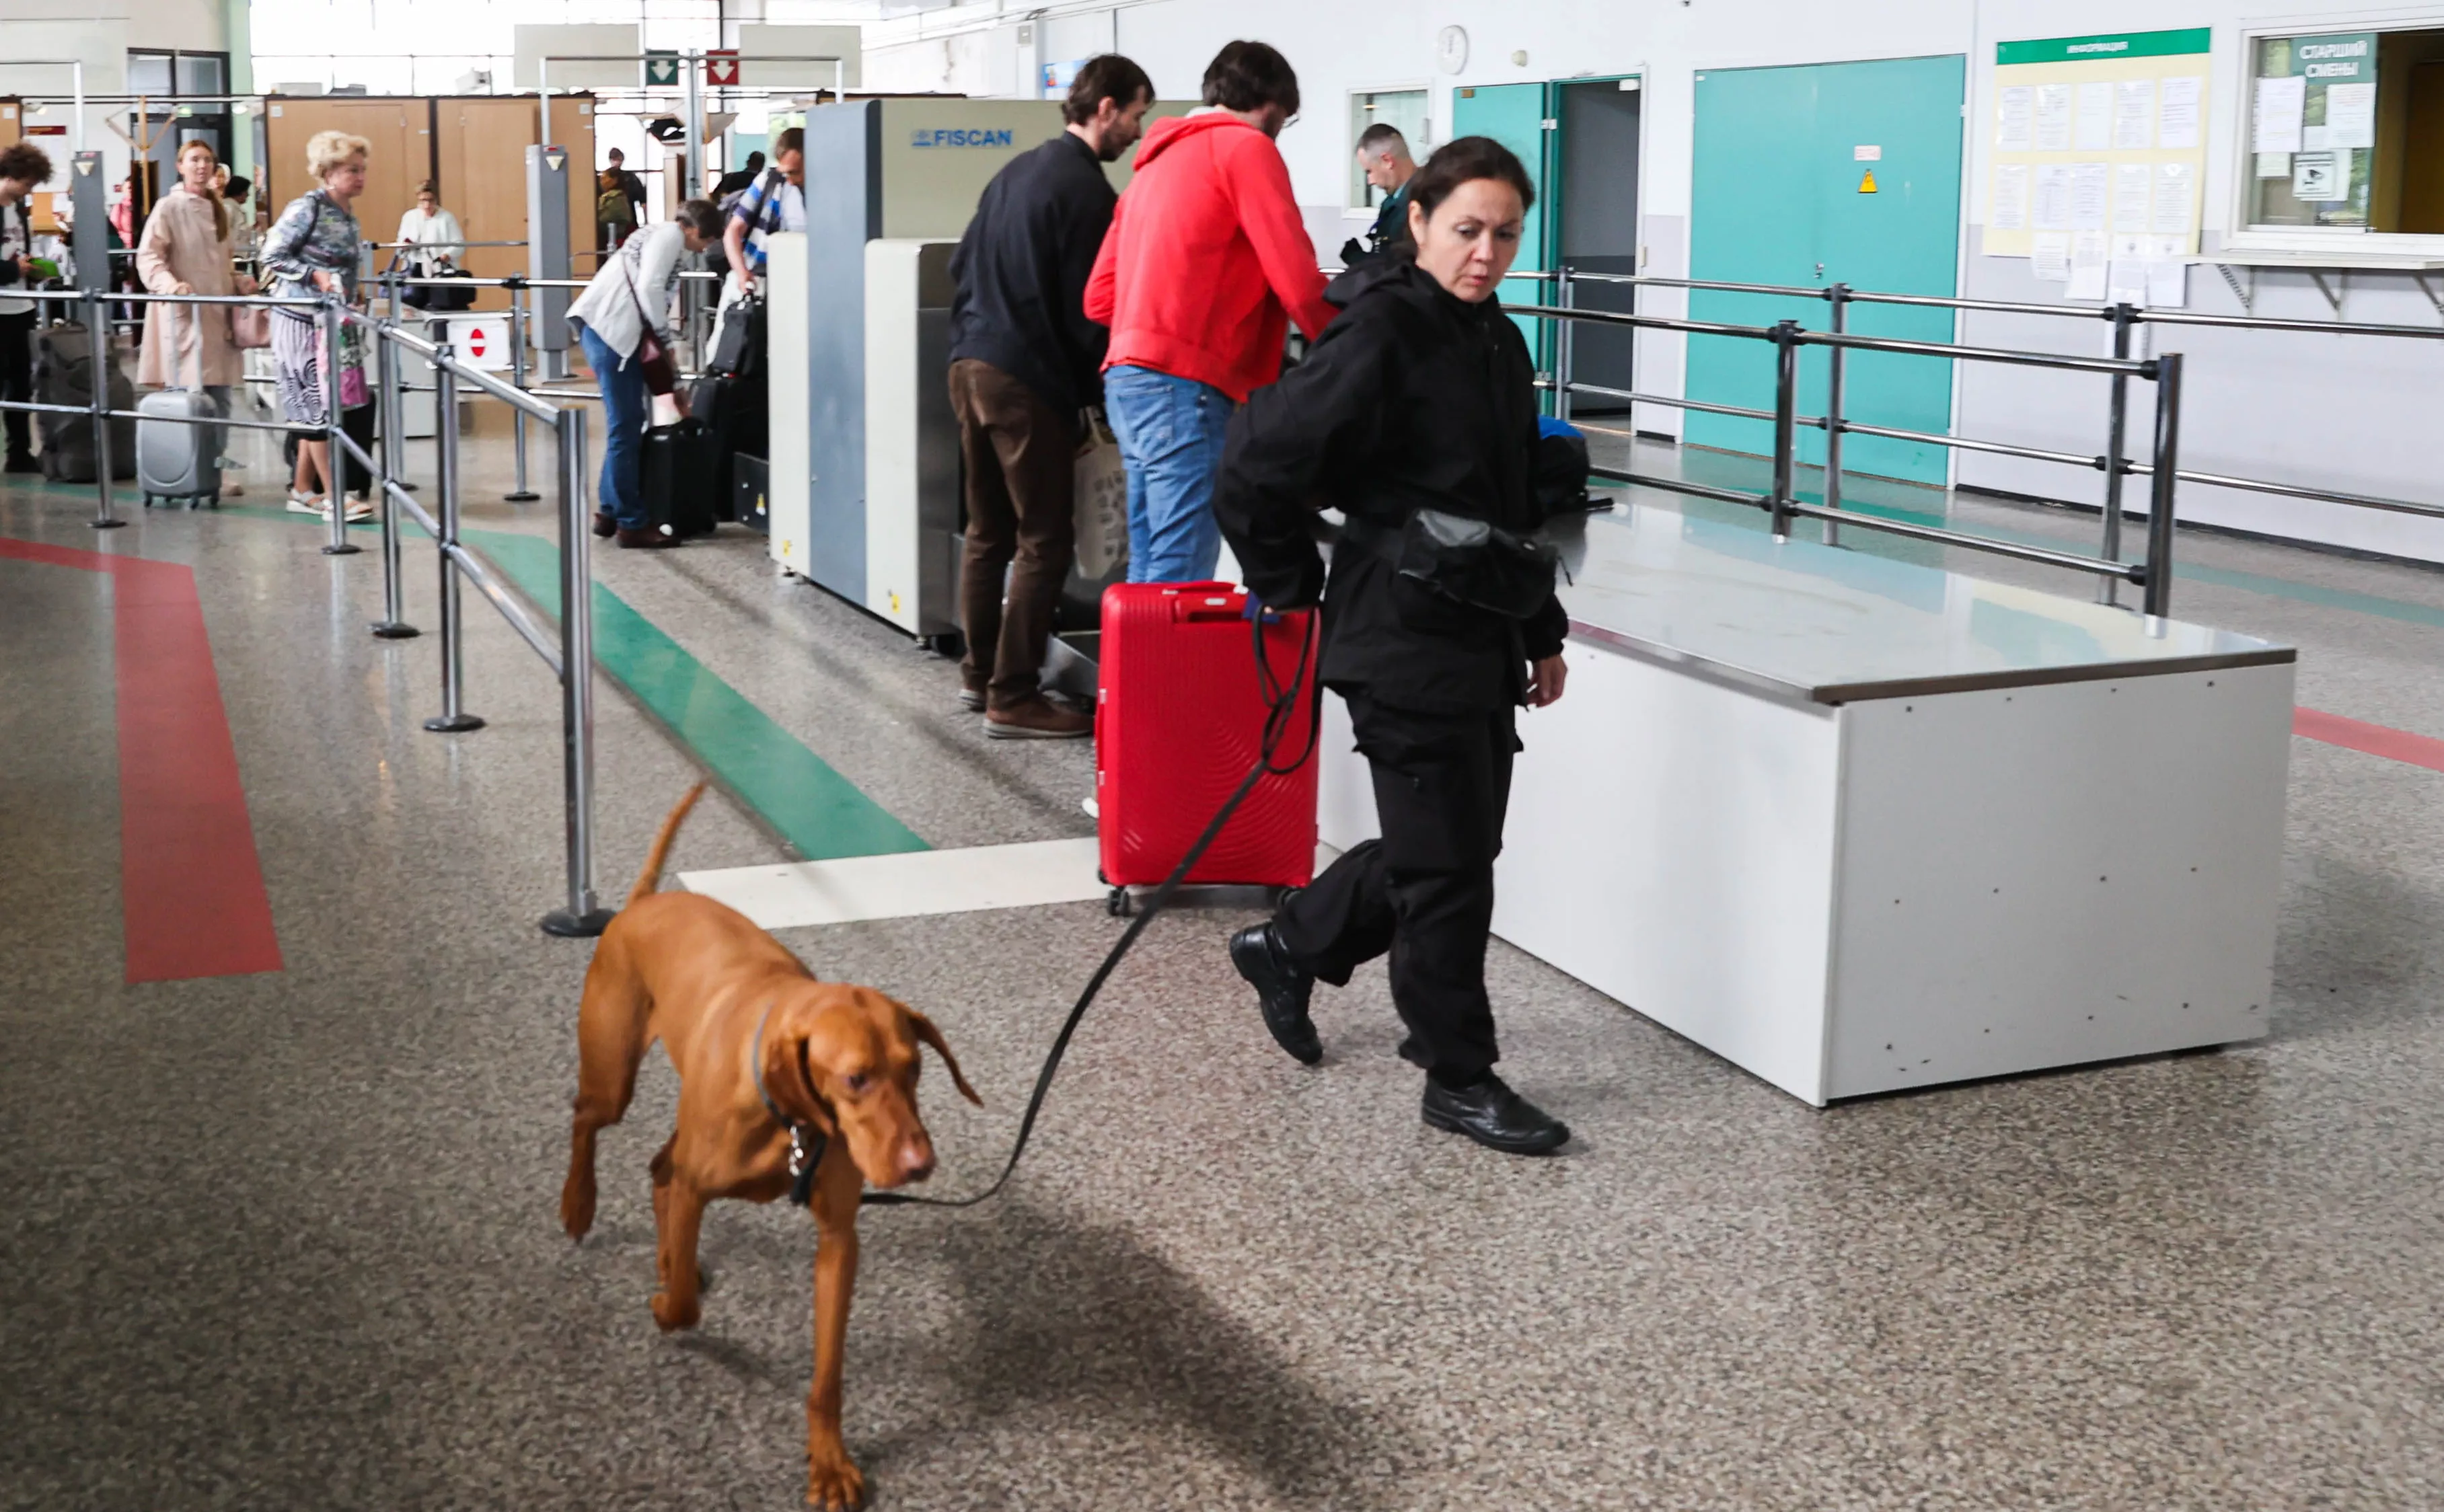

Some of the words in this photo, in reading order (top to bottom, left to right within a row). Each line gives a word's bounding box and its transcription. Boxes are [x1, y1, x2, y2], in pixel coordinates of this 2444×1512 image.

[2299, 40, 2367, 59] СТАРШИЙ
[2305, 62, 2359, 77] СМЕНЫ
[934, 129, 1012, 146] FISCAN
